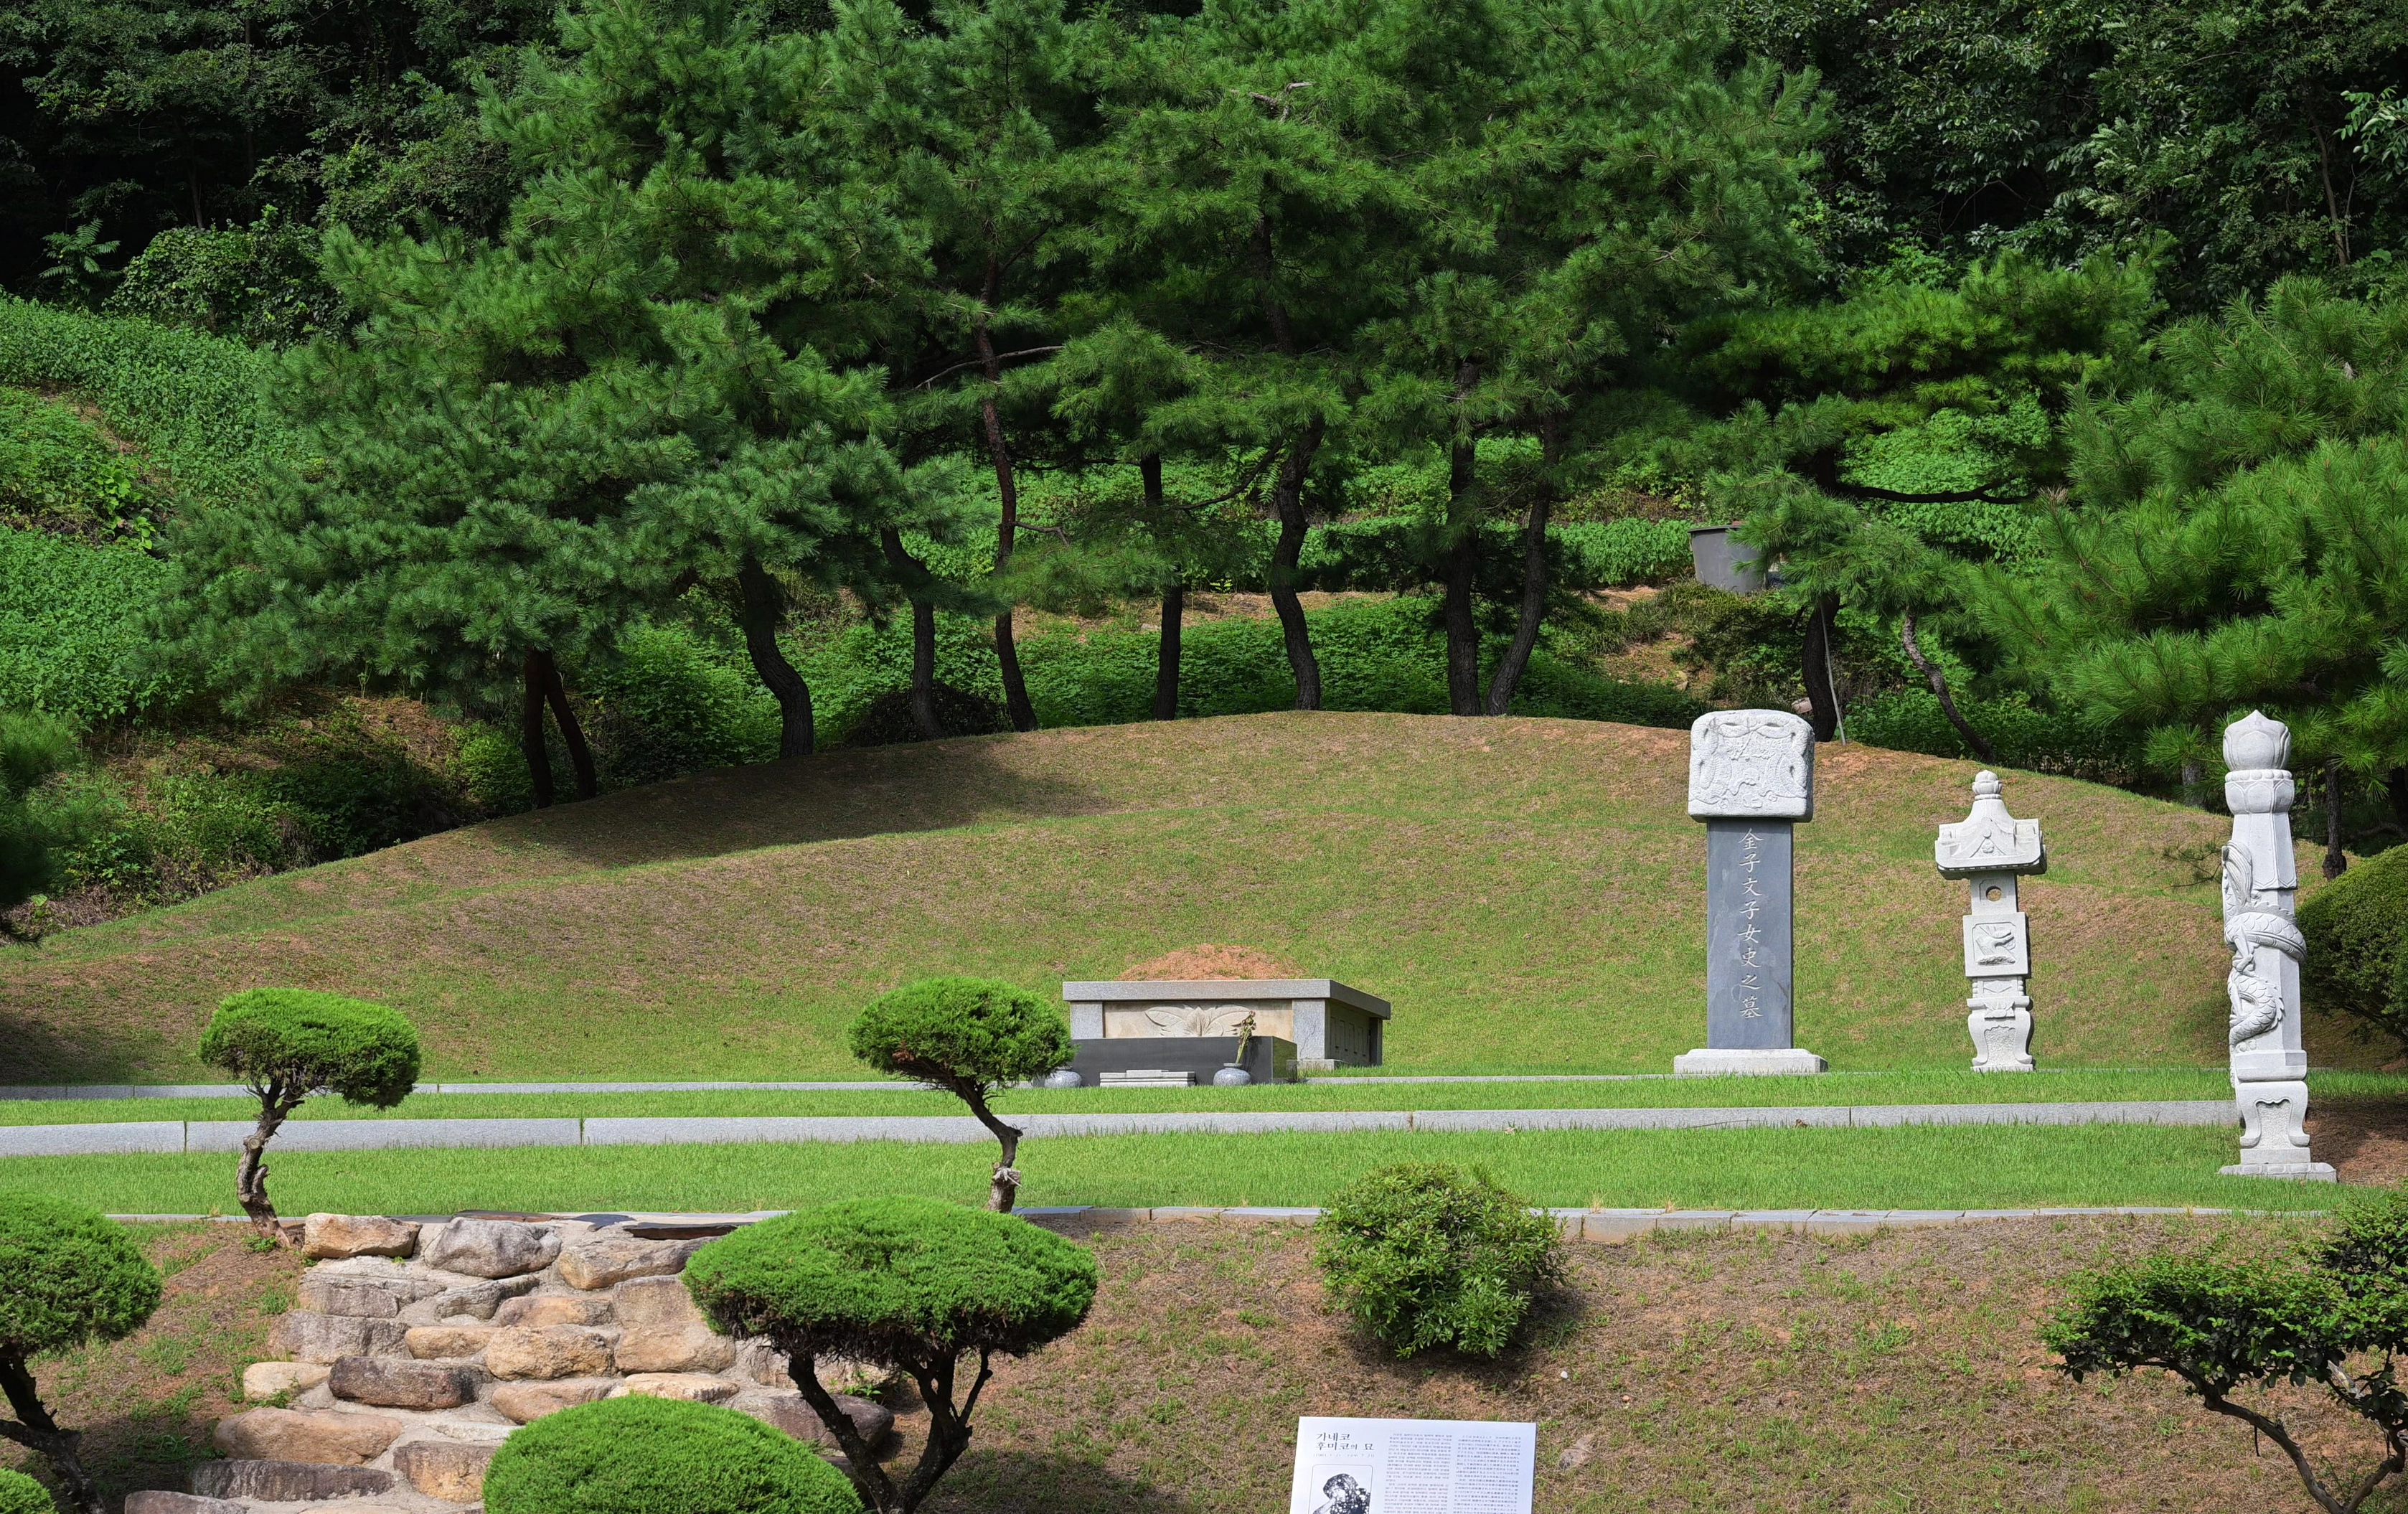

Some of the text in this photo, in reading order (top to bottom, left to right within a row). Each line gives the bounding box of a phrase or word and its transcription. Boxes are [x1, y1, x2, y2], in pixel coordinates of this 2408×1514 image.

[1737, 828, 1764, 1019] 金子文子女史之墓
[1316, 1432, 1350, 1442] 가네코
[1316, 1442, 1358, 1451] 후미코의
